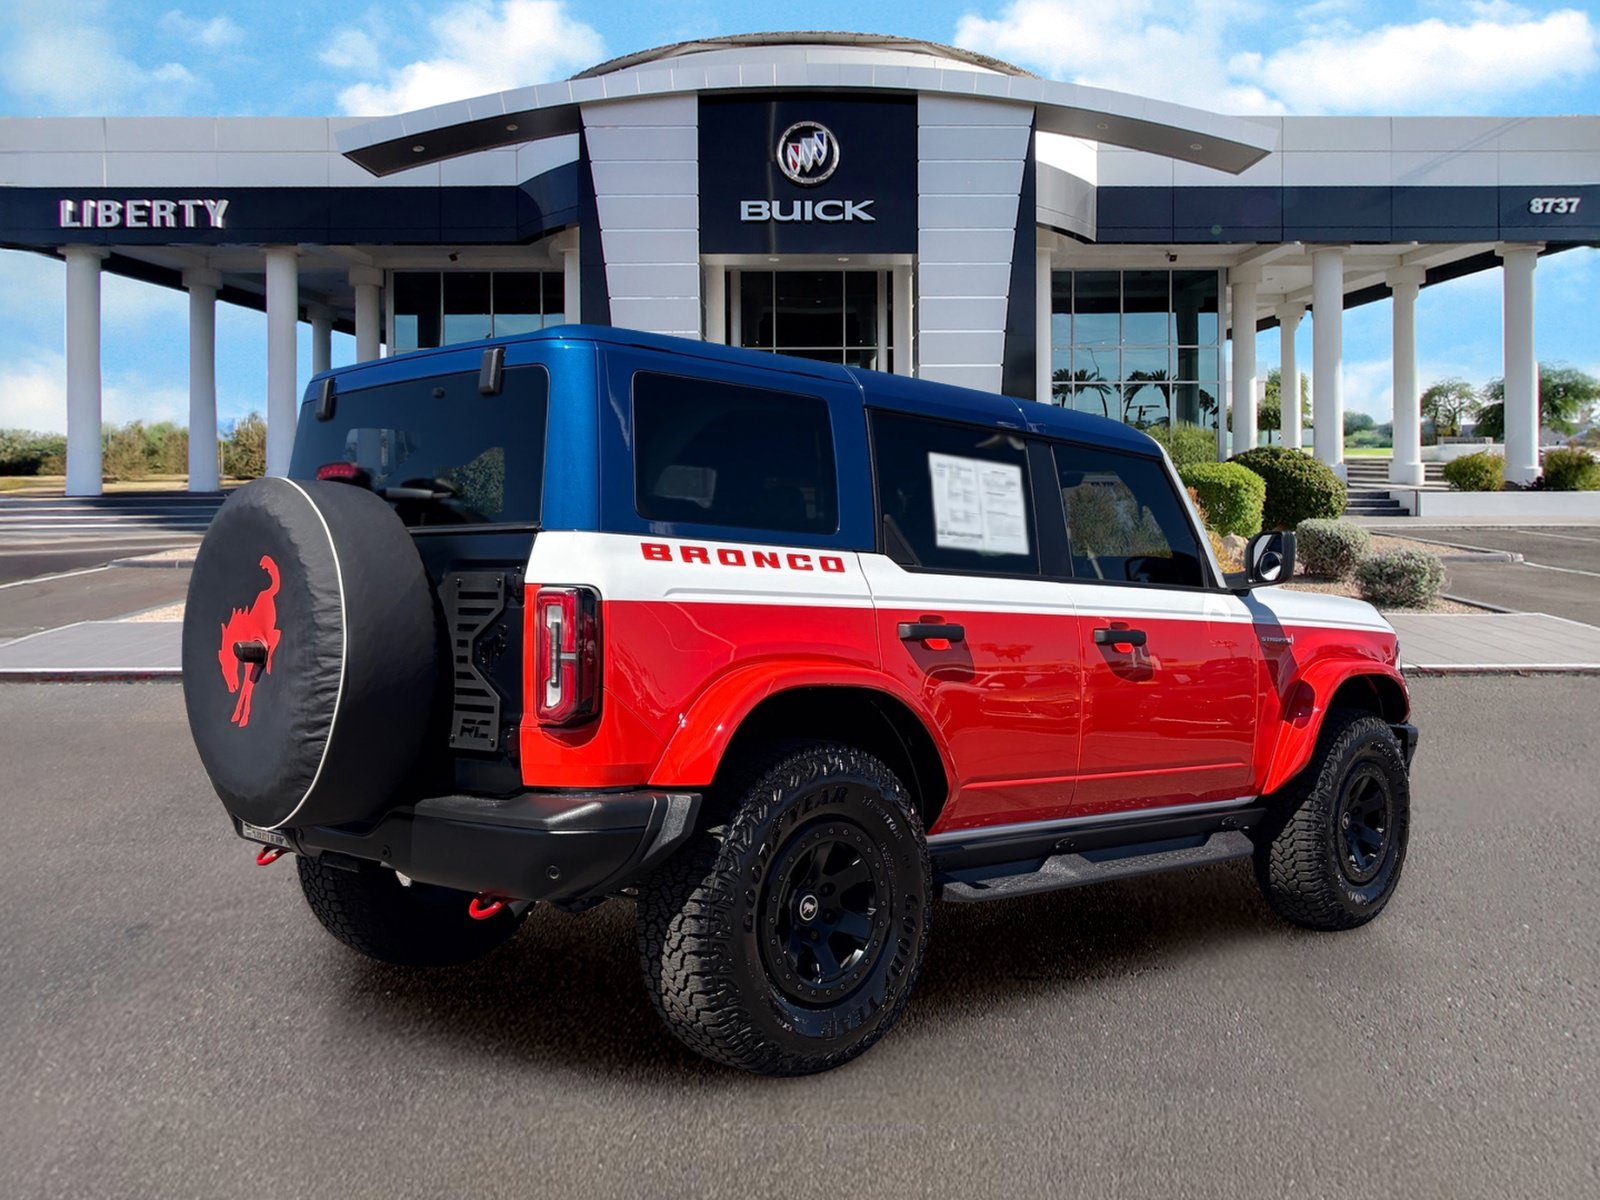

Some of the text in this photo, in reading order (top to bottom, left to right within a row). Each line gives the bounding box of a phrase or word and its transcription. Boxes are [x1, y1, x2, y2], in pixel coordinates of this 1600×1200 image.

[59, 198, 229, 228] LIBERTY
[740, 199, 876, 221] BUICK
[1529, 197, 1581, 214] 8737
[640, 543, 846, 573] BRONCO
